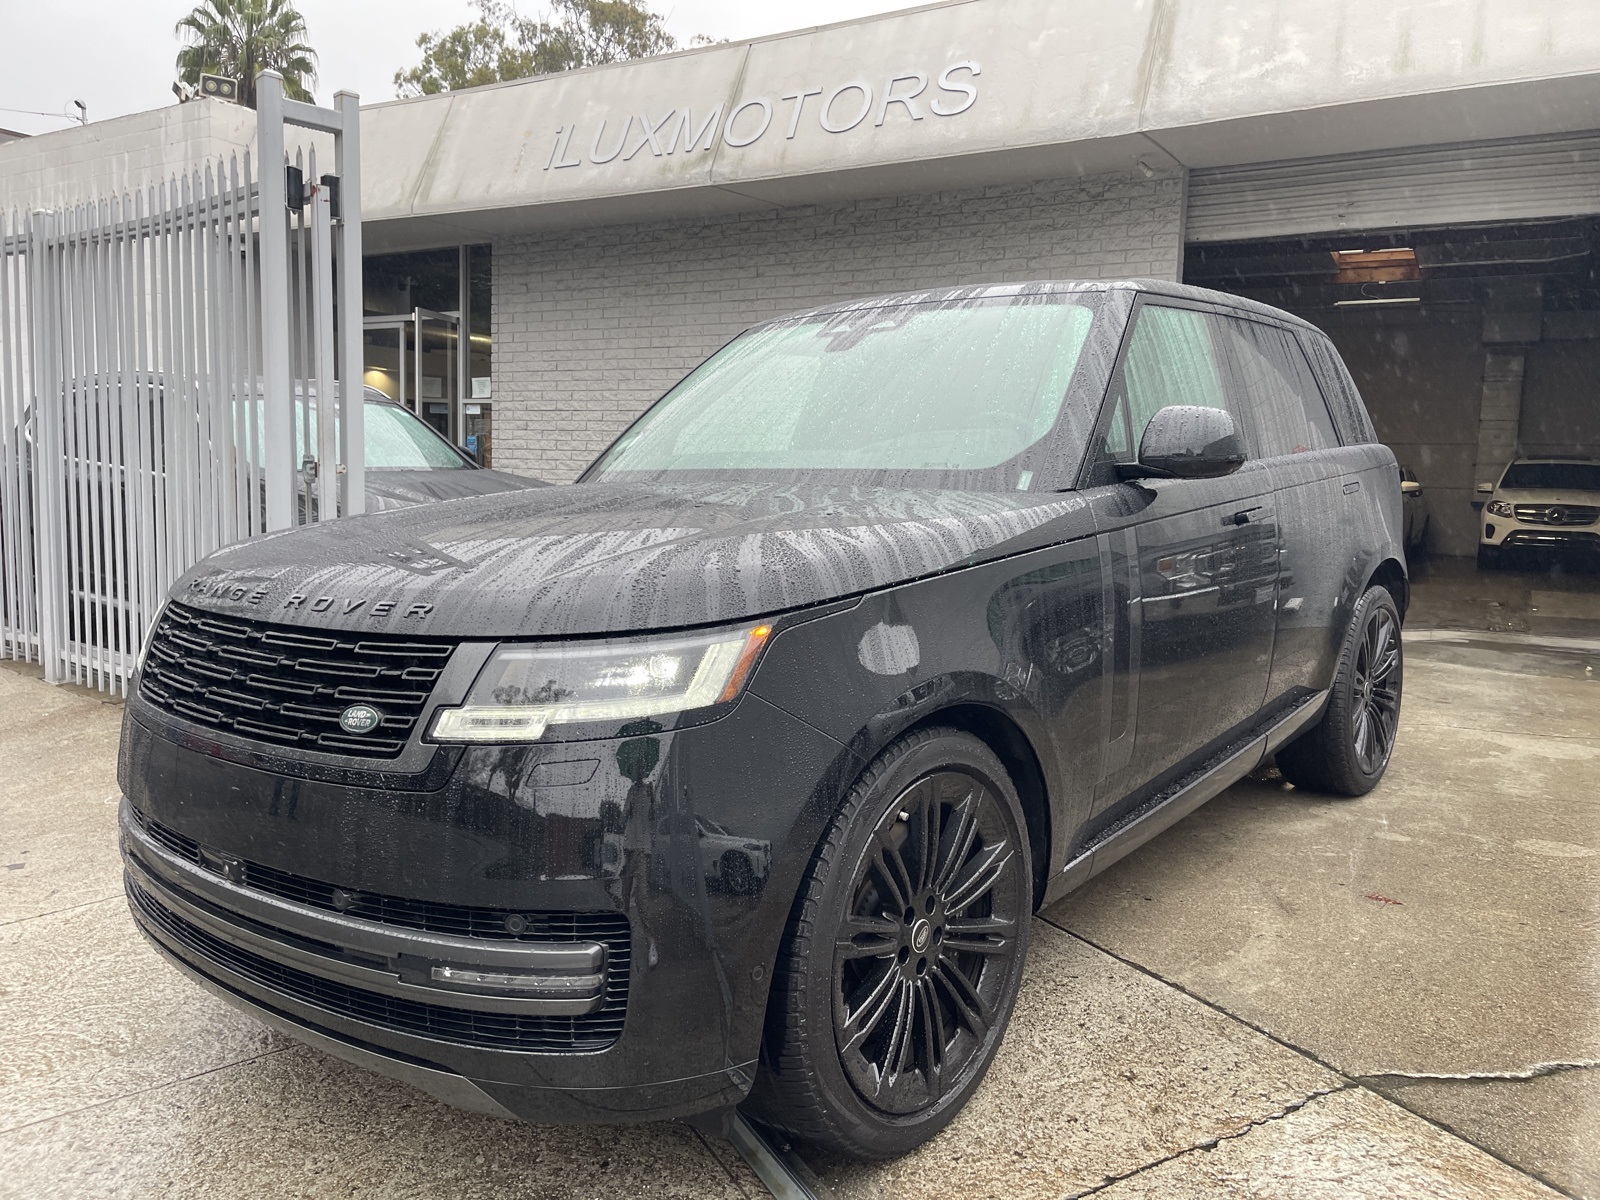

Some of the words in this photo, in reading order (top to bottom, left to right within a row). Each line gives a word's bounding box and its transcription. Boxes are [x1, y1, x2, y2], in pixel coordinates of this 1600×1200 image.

[188, 578, 268, 605] RANGE
[283, 594, 434, 619] ROVER
[347, 709, 367, 718] LAND
[347, 718, 371, 727] ROVER
